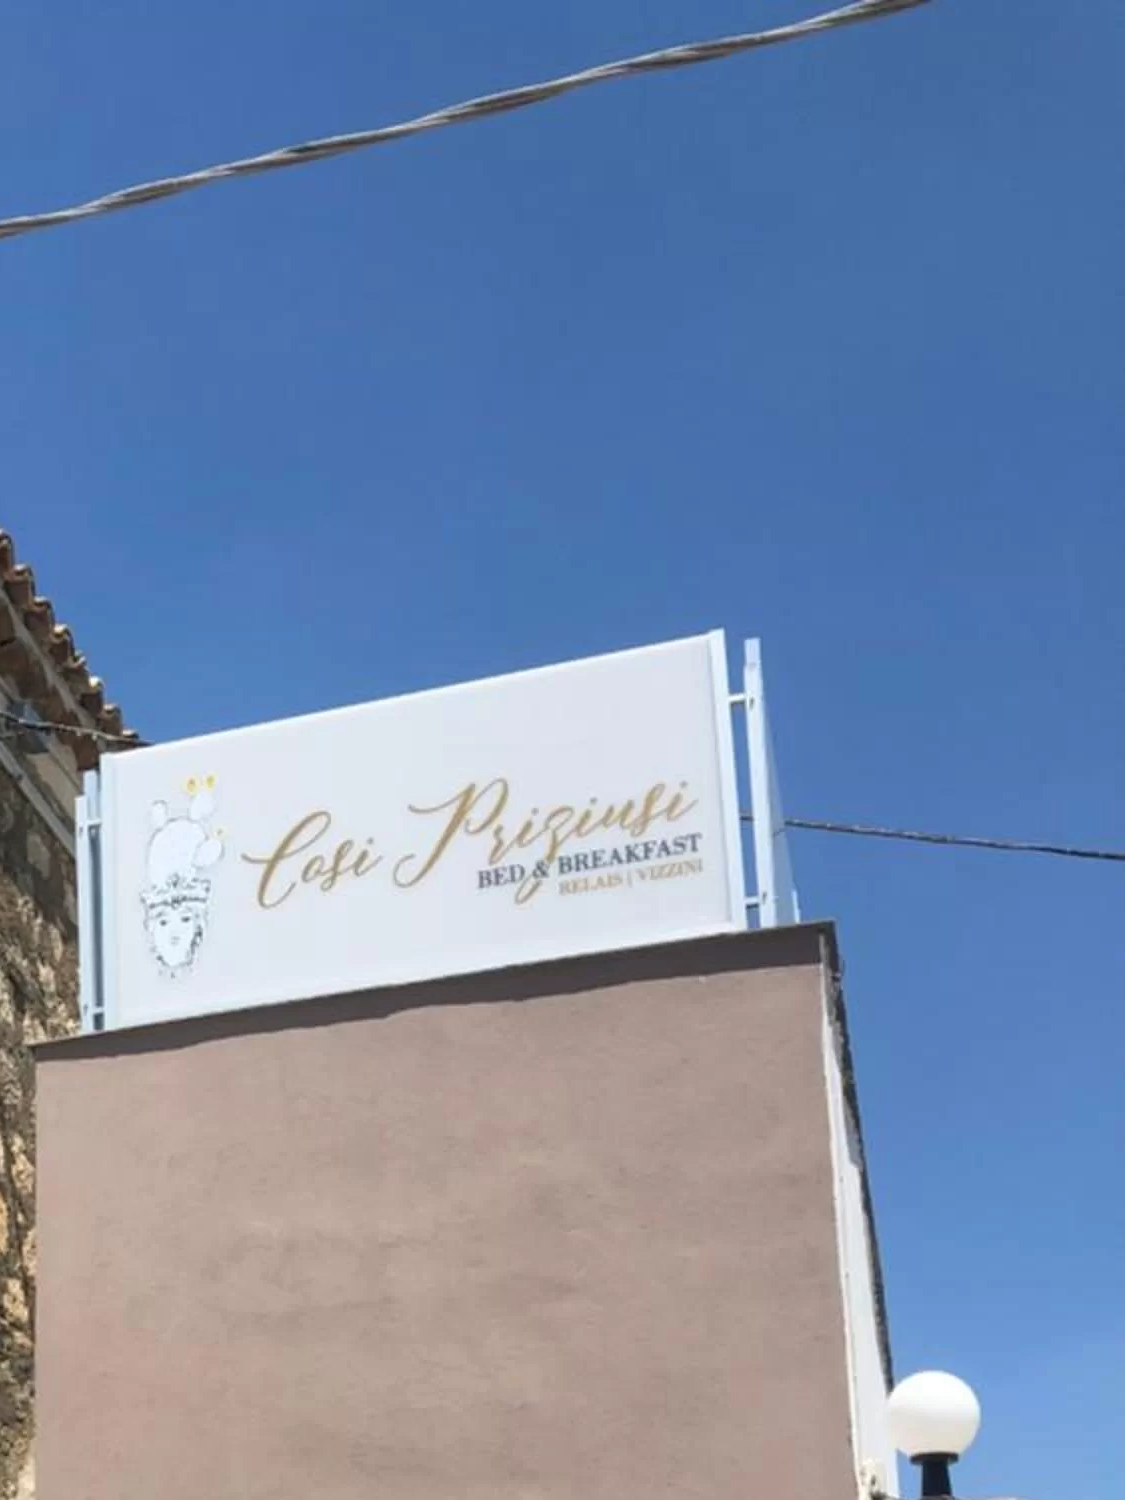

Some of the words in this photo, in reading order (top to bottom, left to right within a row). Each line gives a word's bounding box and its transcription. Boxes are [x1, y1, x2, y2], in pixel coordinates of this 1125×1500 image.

[477, 863, 526, 889] BED
[531, 859, 549, 879] &
[557, 832, 703, 876] BREAKFAST
[558, 872, 624, 896] RELAIS
[635, 858, 703, 881] VIZZINI
